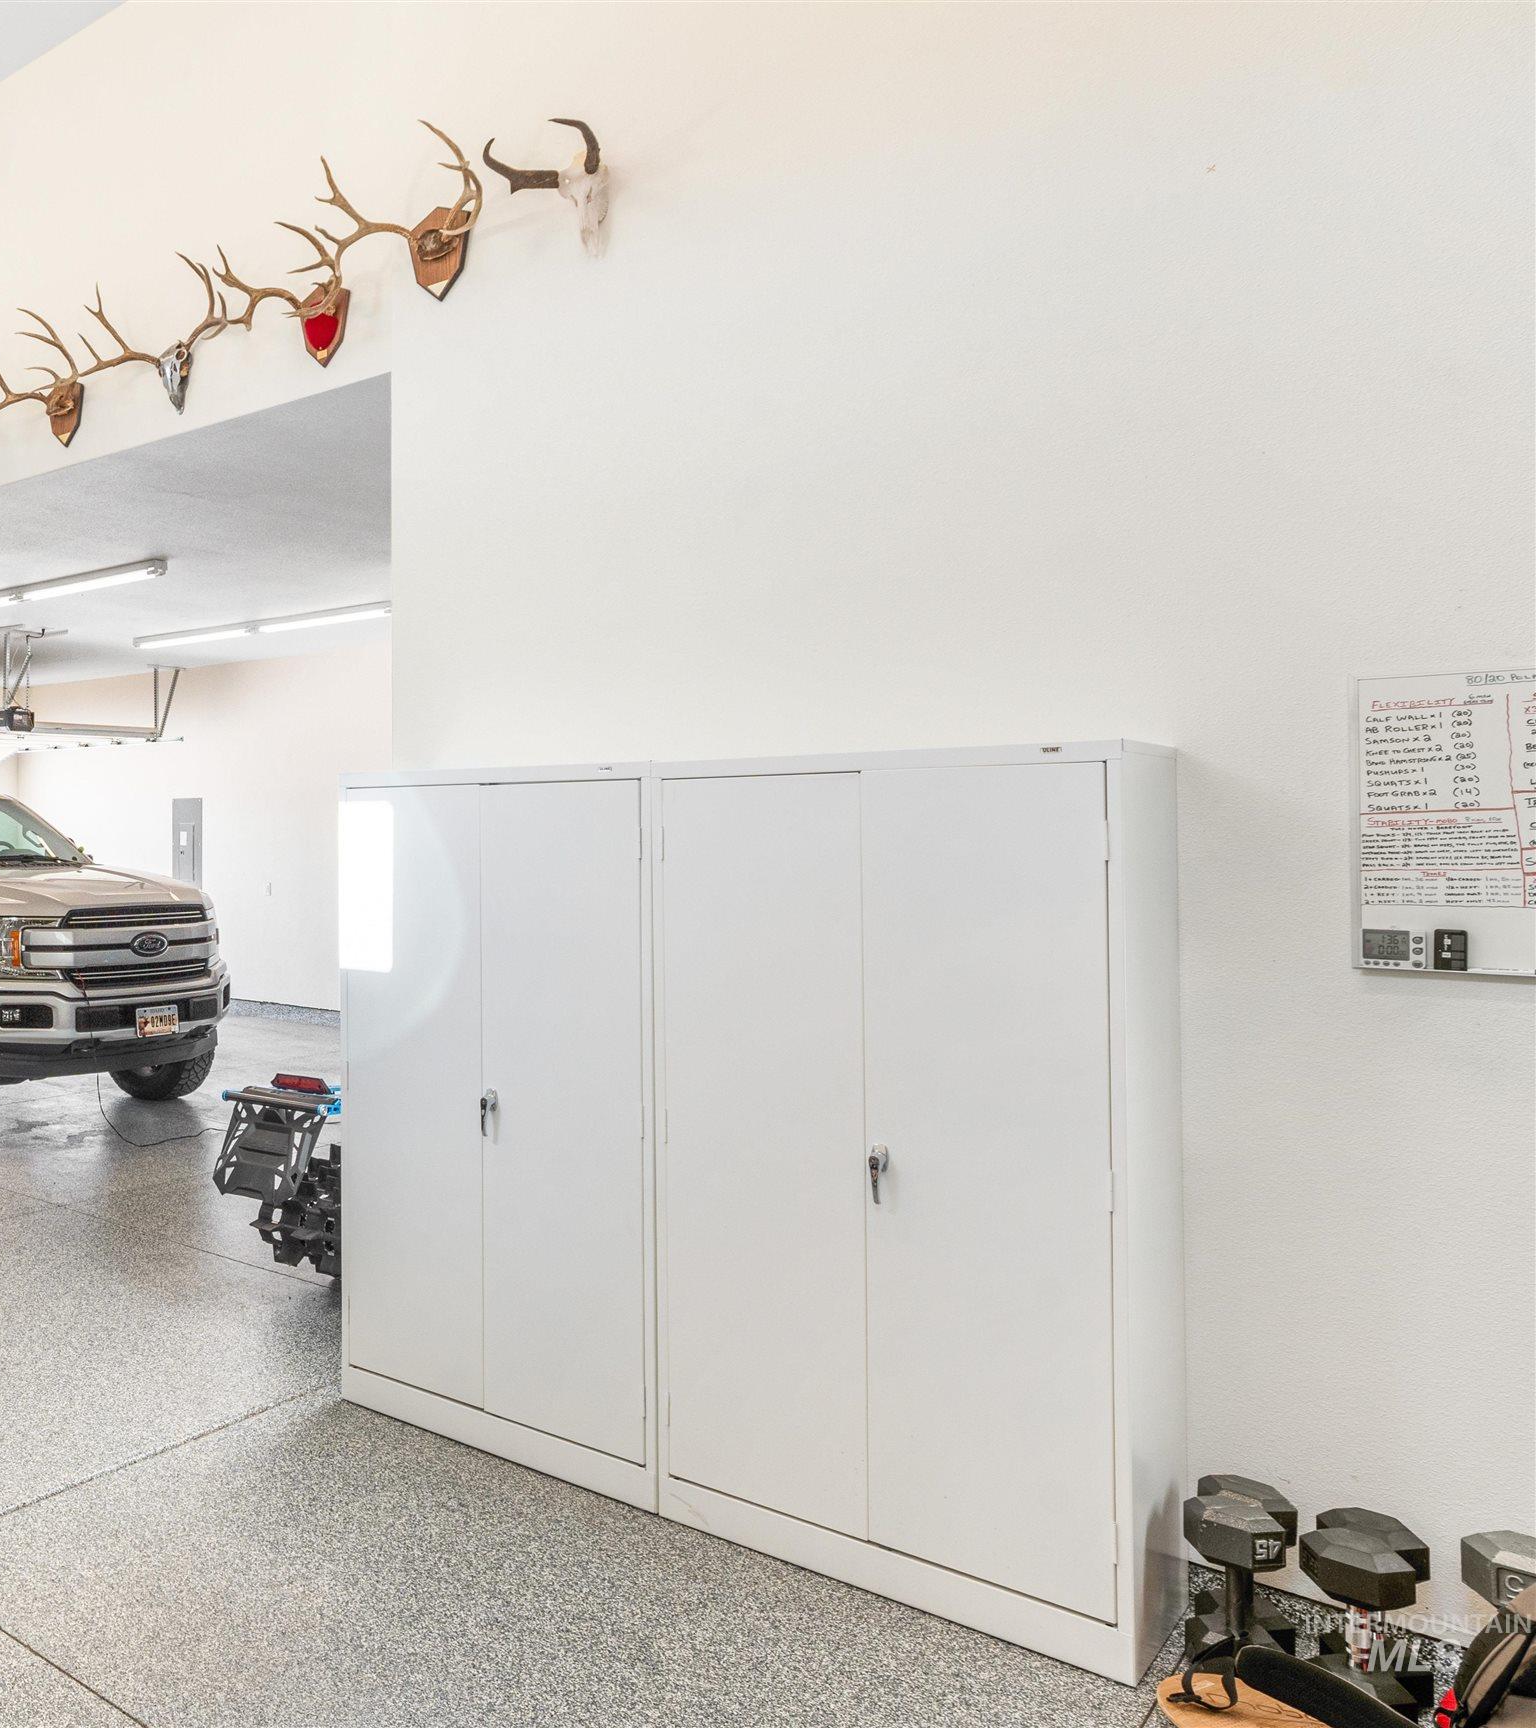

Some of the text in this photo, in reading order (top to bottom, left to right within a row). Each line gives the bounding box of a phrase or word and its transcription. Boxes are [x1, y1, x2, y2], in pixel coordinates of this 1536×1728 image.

[1372, 698, 1455, 709] FLEXIBILITY
[1365, 715, 1393, 723] CALF
[1396, 714, 1428, 722] WALL
[1365, 726, 1380, 734] AB
[1384, 723, 1429, 733] ROLLER
[1365, 737, 1410, 745] SAMSON
[1423, 734, 1432, 743] 2
[1435, 744, 1444, 753] 2
[1366, 768, 1409, 776] PUSHUPS
[1366, 779, 1411, 788] SQUATS
[1366, 791, 1390, 799] FOOT
[1391, 790, 1421, 798] GRAB
[1429, 788, 1438, 797] 2
[1367, 804, 1412, 812] SQUATS
[1254, 1539, 1282, 1560] 45
